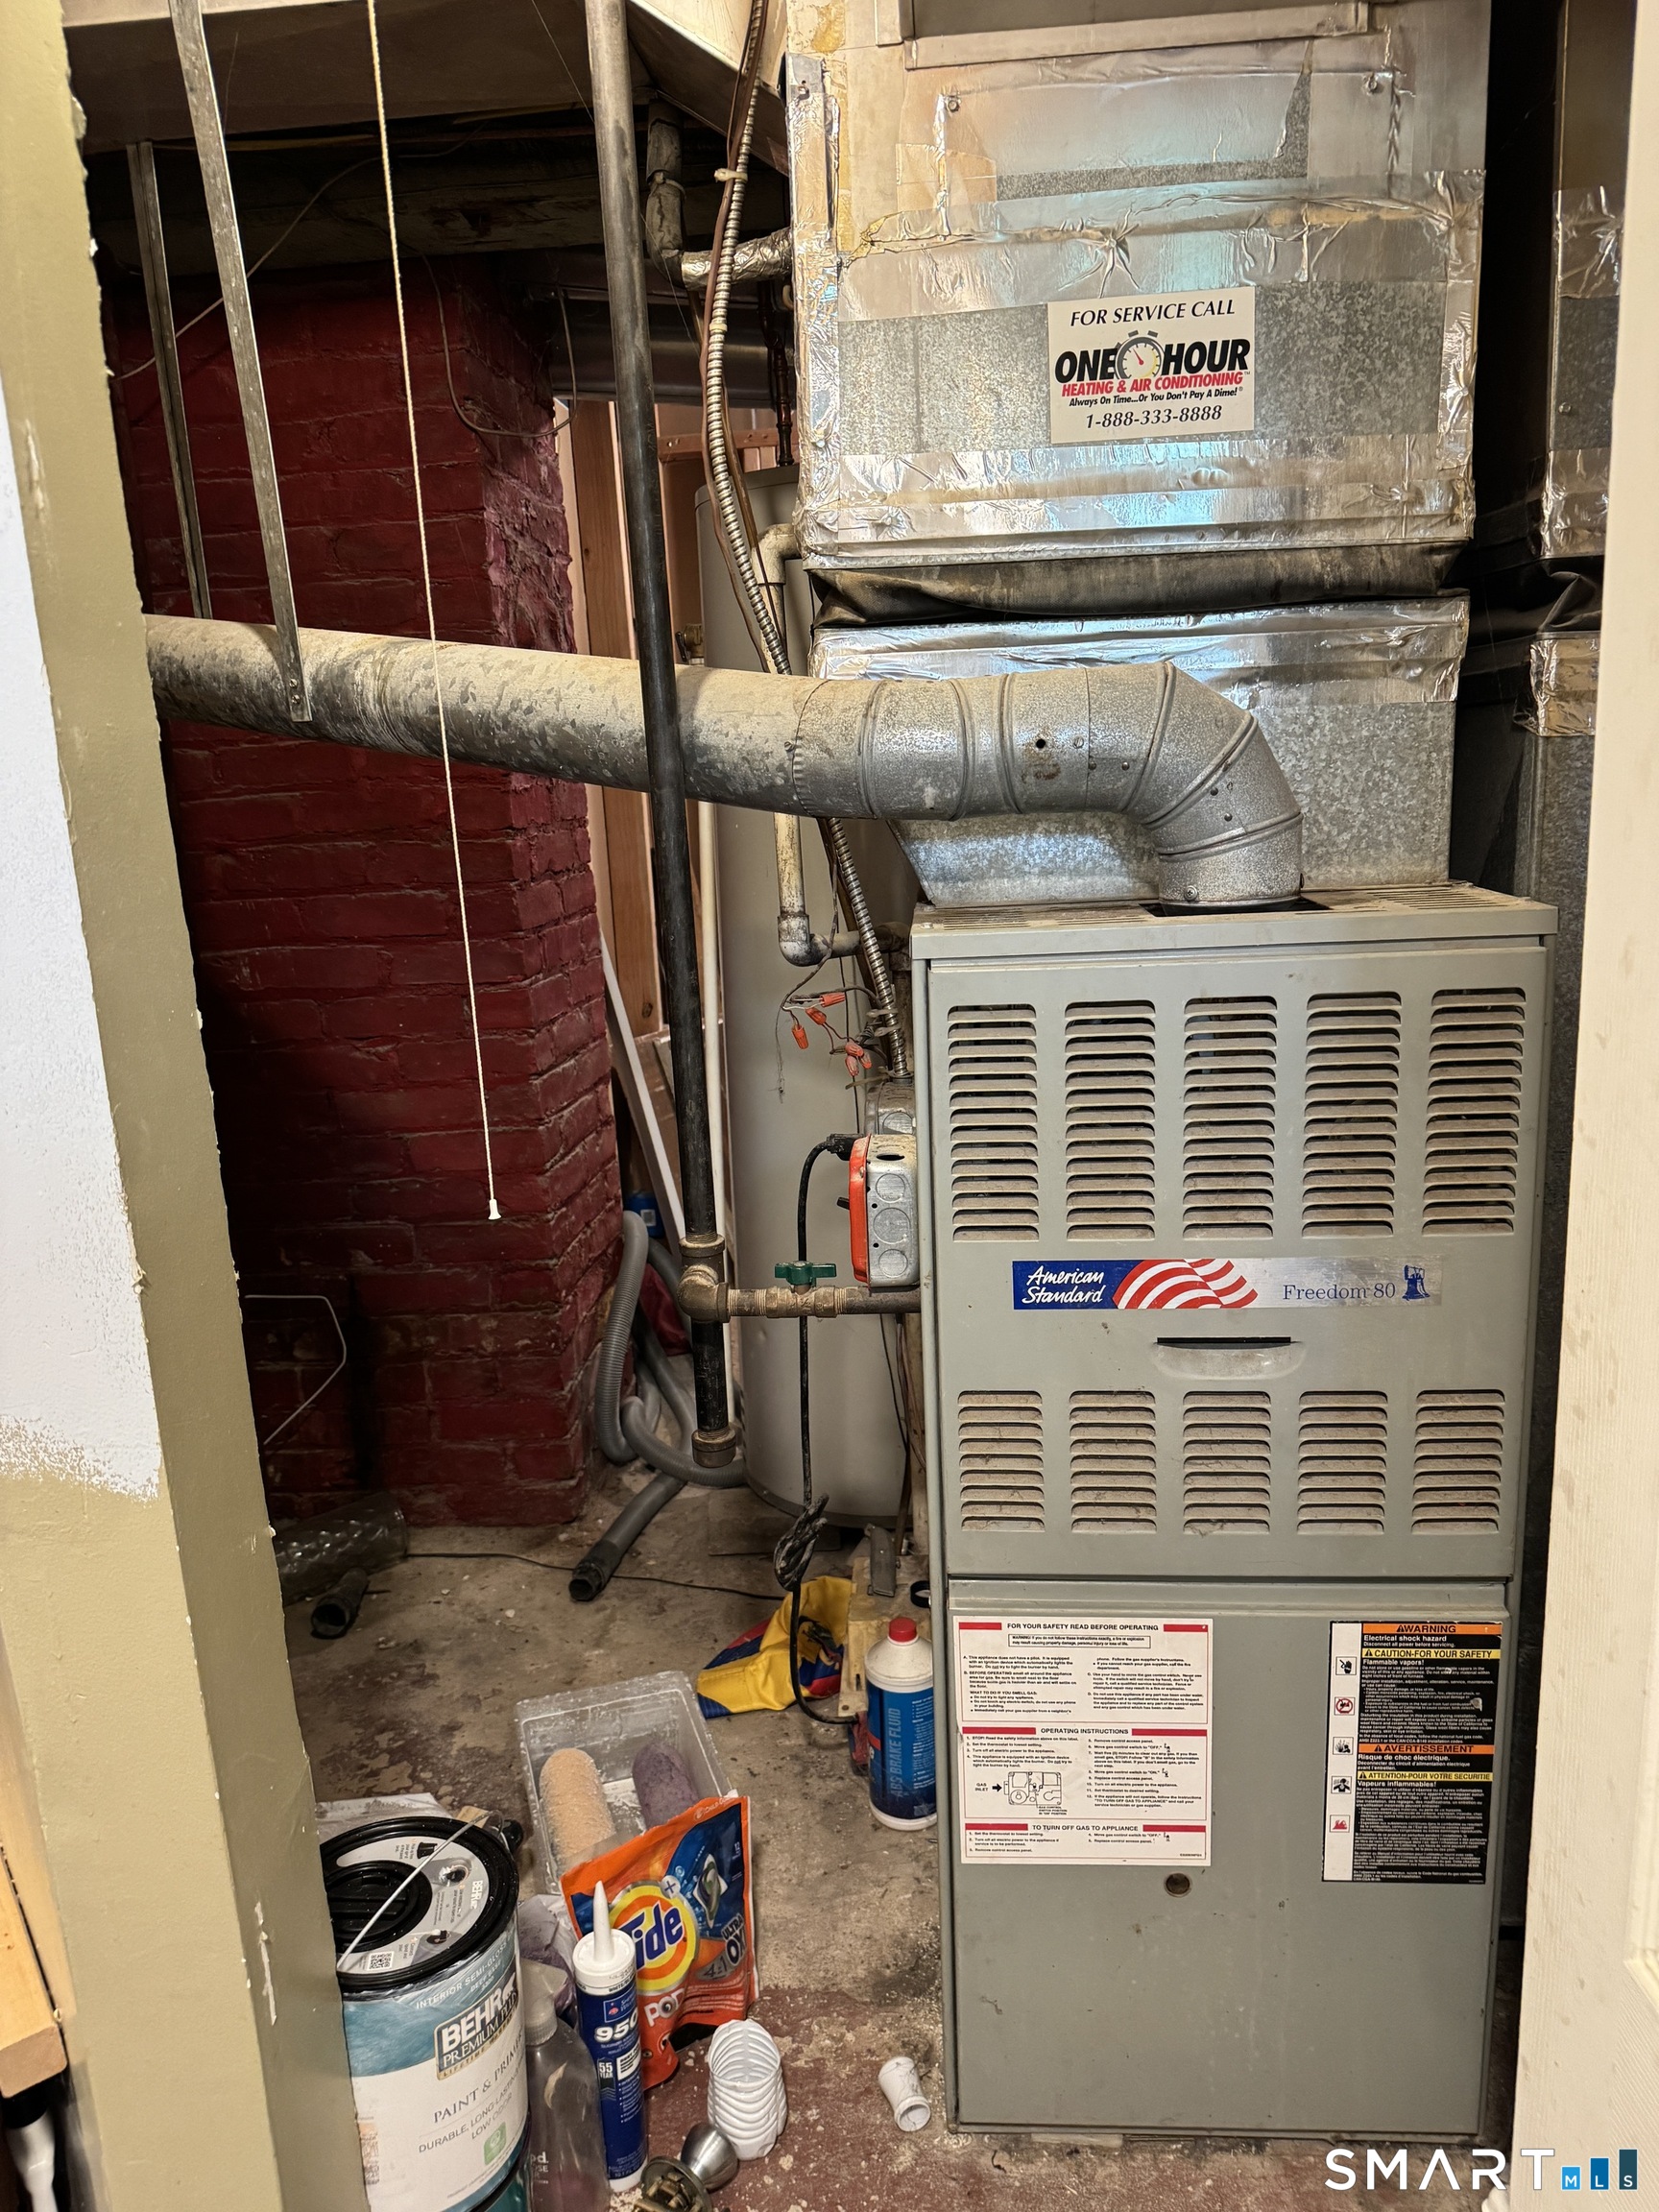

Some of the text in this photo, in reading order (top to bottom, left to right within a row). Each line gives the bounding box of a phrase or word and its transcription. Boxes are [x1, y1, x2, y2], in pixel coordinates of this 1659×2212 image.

[1070, 300, 1236, 326] FOR SERVICE CALL
[1055, 339, 1250, 383] ONE HOUR
[1061, 371, 1243, 397] HEATING & AIR CONDITIONING
[1069, 395, 1098, 407] Always
[1100, 396, 1111, 405] On
[1151, 393, 1164, 401] You
[1166, 391, 1187, 400] Don't
[1190, 390, 1204, 400] Pay
[1207, 389, 1213, 397] A
[1214, 387, 1238, 397] Dime!
[1086, 405, 1223, 428] 1-888-333-8888
[1027, 1266, 1104, 1286] American
[1022, 1286, 1106, 1305] Standard
[1283, 1282, 1396, 1301] Freedom 80
[888, 1708, 903, 1798] ABS BRAKE FLUID
[472, 1880, 483, 1901] BEHR
[722, 1913, 744, 1940] ULTRA
[416, 1941, 508, 2009] INTERIOR SEMI-GLOSS
[442, 1987, 502, 2055] BEHR
[443, 2017, 500, 2068] PREMIUM
[599, 2062, 613, 2072] 55
[434, 2088, 479, 2124] PAINT
[482, 2079, 492, 2093] &
[419, 2124, 469, 2153] DURABLE,
[472, 2117, 491, 2140] LOW
